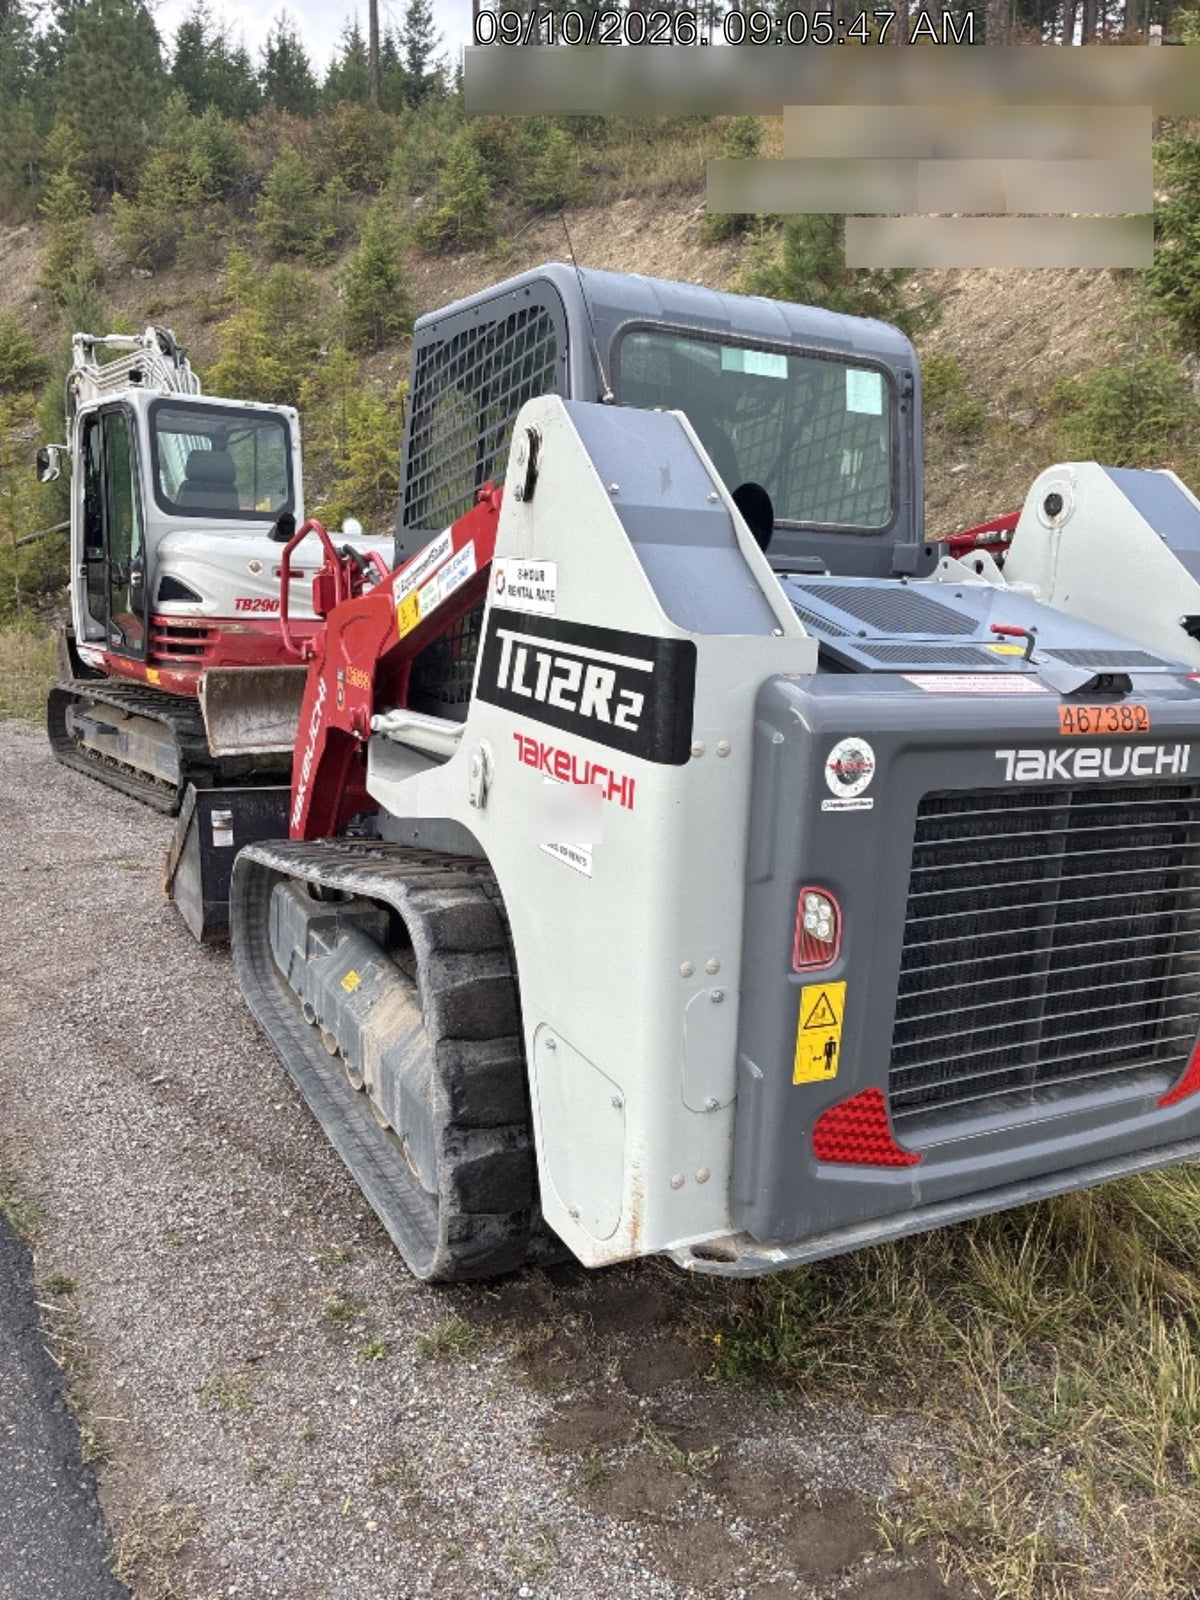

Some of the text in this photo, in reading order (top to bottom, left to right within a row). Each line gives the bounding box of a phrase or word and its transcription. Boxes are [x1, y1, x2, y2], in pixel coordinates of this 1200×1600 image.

[234, 597, 280, 612] TB290
[507, 583, 556, 603] RENTAL RATE
[496, 628, 655, 732] TL12R2
[1062, 704, 1149, 734] 467382
[994, 743, 1191, 782] TAKEUCHI
